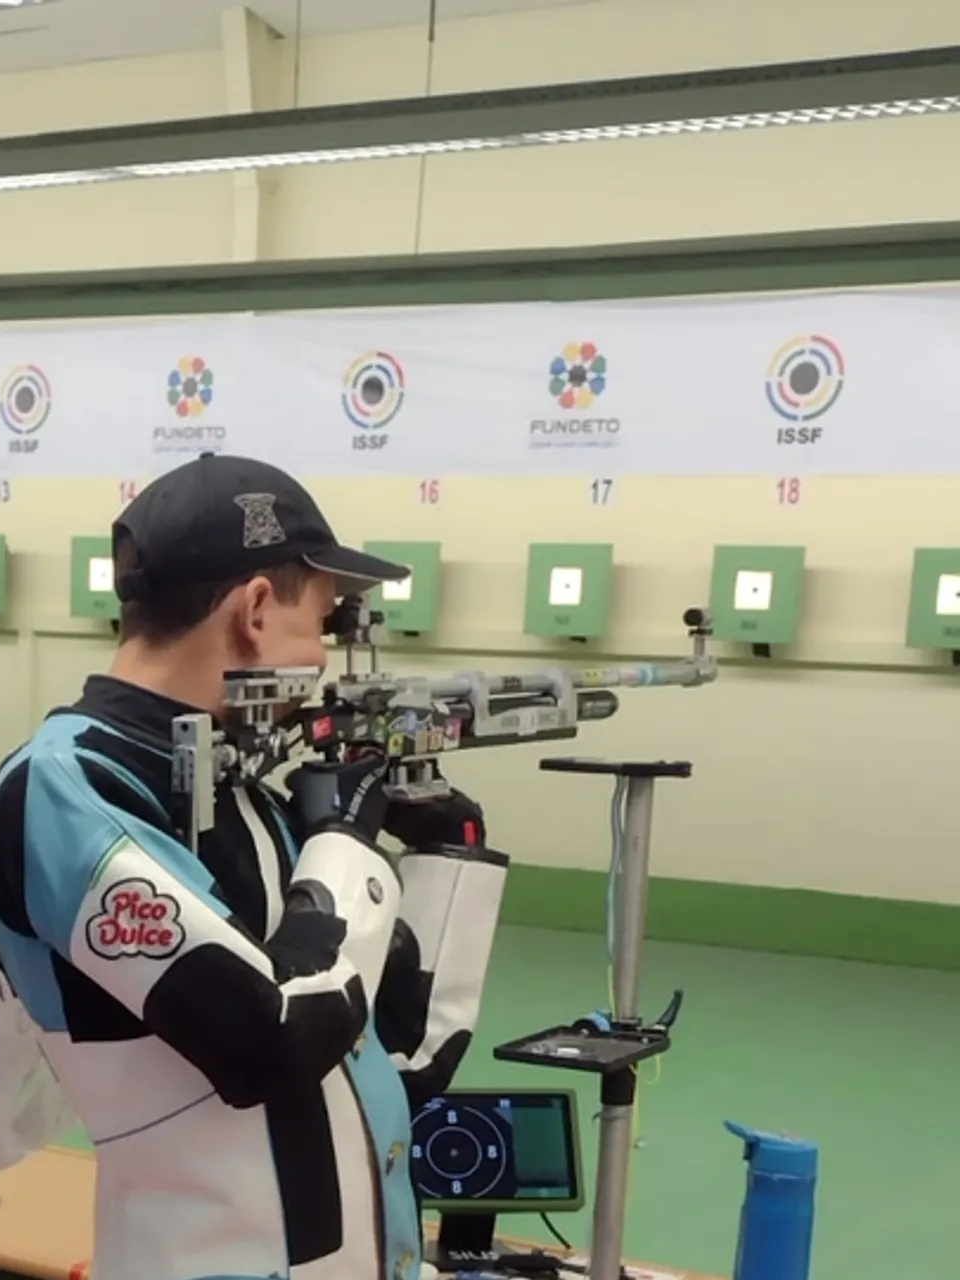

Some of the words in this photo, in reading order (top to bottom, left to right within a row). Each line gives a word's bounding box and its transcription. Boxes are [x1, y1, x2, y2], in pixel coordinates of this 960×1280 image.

[152, 426, 228, 441] FUNDETO
[529, 418, 621, 435] FUNDETO
[351, 434, 390, 451] ISSF
[776, 426, 823, 445] ISSF
[7, 439, 39, 454] ISSF
[419, 479, 440, 504] 16
[590, 478, 613, 505] 17
[775, 477, 801, 505] 18
[112, 891, 167, 920] Pico
[98, 918, 173, 946] Dulce
[447, 1110, 458, 1124] 8
[411, 1144, 422, 1159] 8
[452, 1180, 462, 1195] 8
